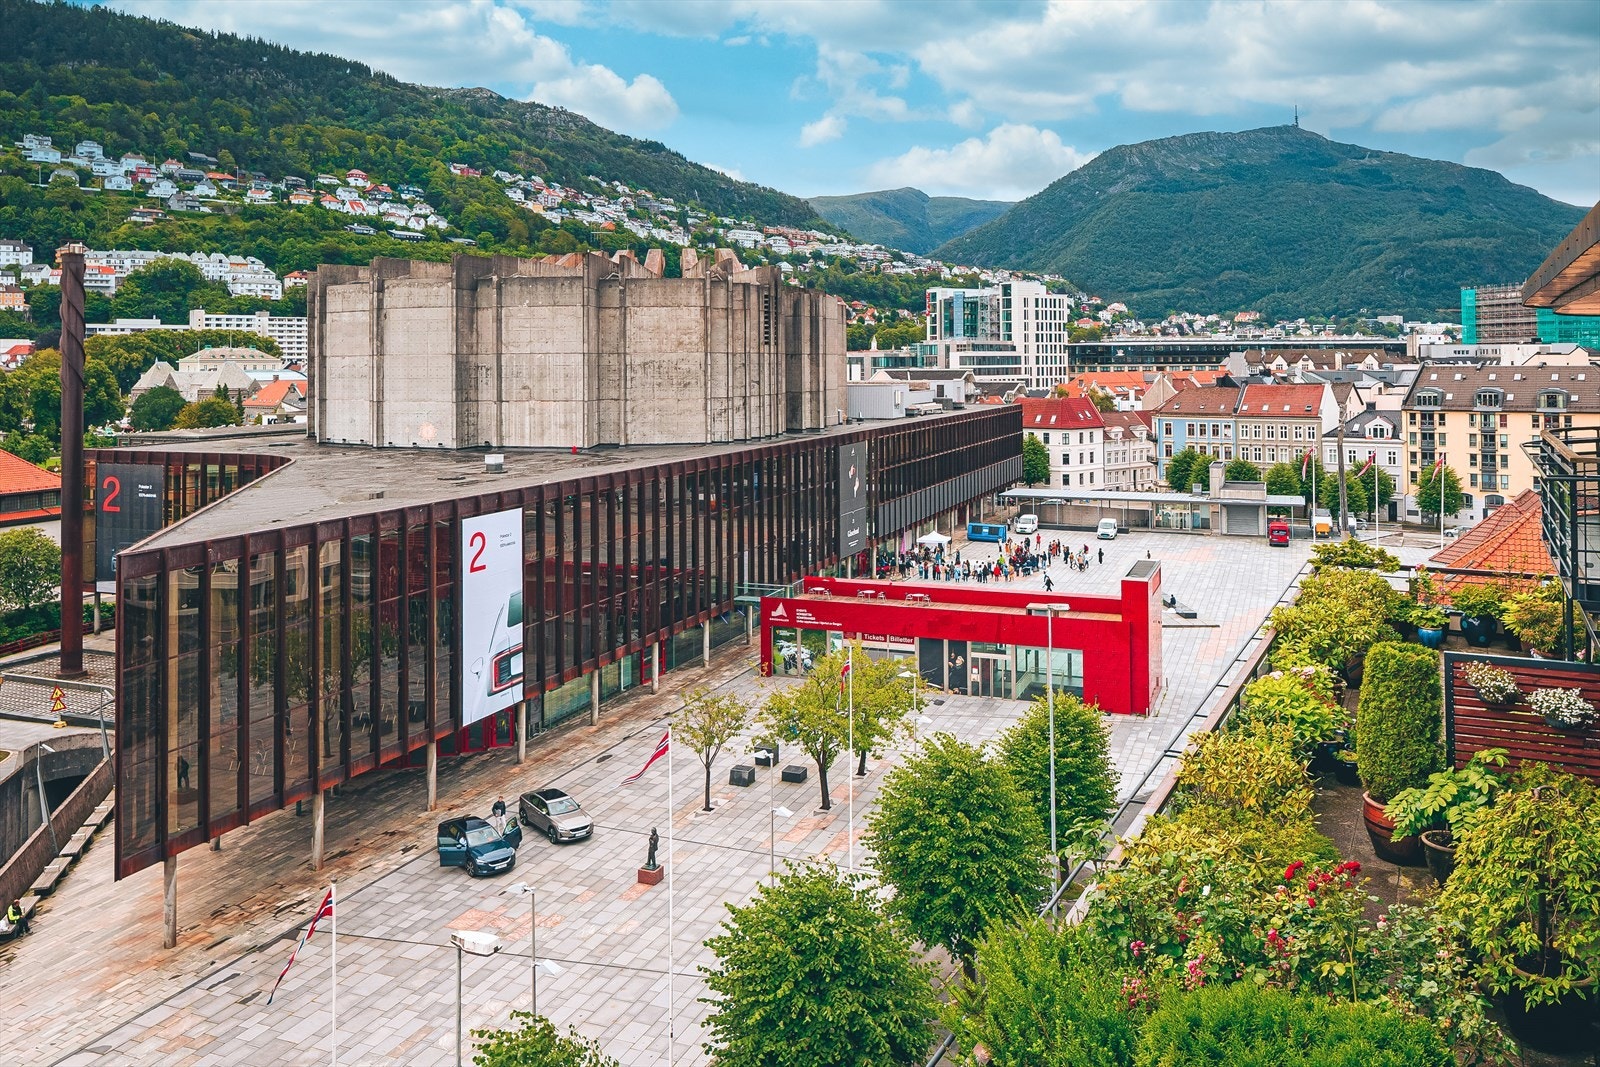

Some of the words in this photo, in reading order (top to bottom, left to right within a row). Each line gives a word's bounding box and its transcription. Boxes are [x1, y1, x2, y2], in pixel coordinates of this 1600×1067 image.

[103, 475, 120, 512] 2
[470, 531, 487, 573] 2
[863, 633, 885, 641] Tickets
[890, 635, 914, 643] Billetter
